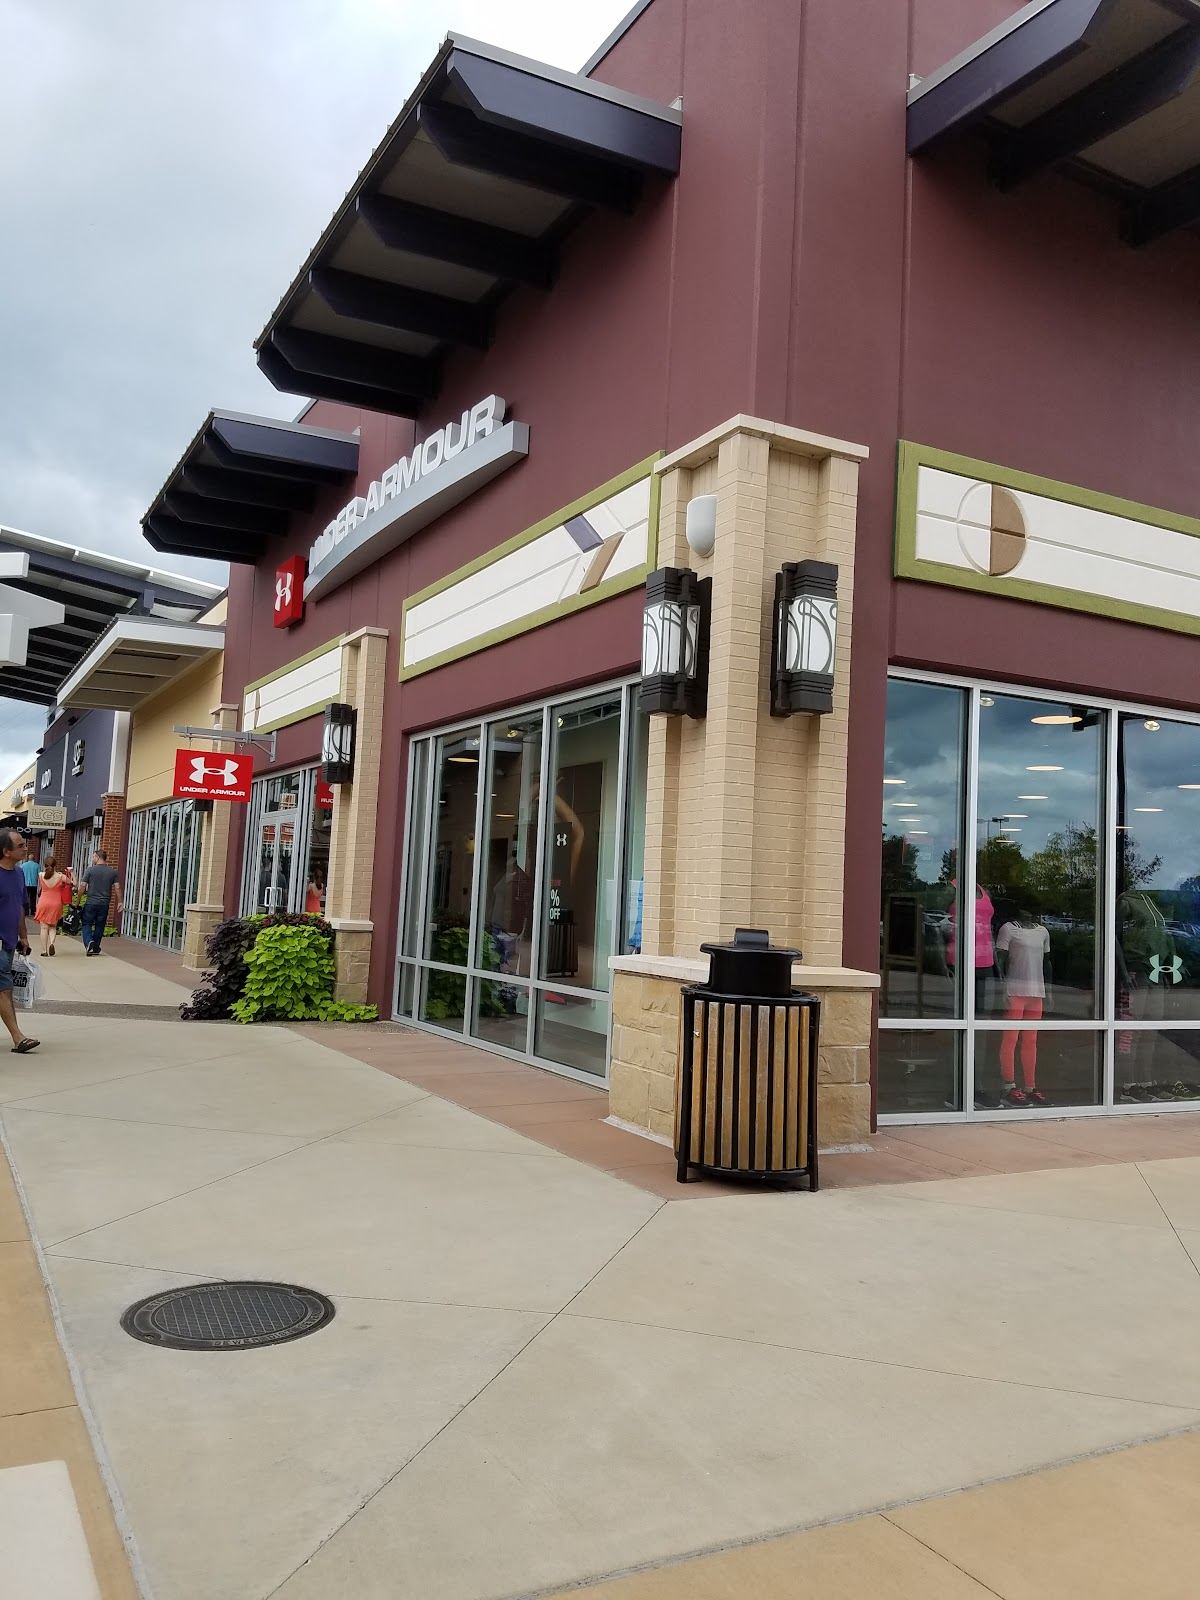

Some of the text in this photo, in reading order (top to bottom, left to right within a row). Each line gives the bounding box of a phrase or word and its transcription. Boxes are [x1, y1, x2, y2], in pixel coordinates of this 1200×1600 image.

[309, 394, 505, 574] DER ARMOUR
[210, 788, 246, 796] ARMOUR
[32, 808, 63, 822] UGG
[550, 907, 560, 920] OFF
